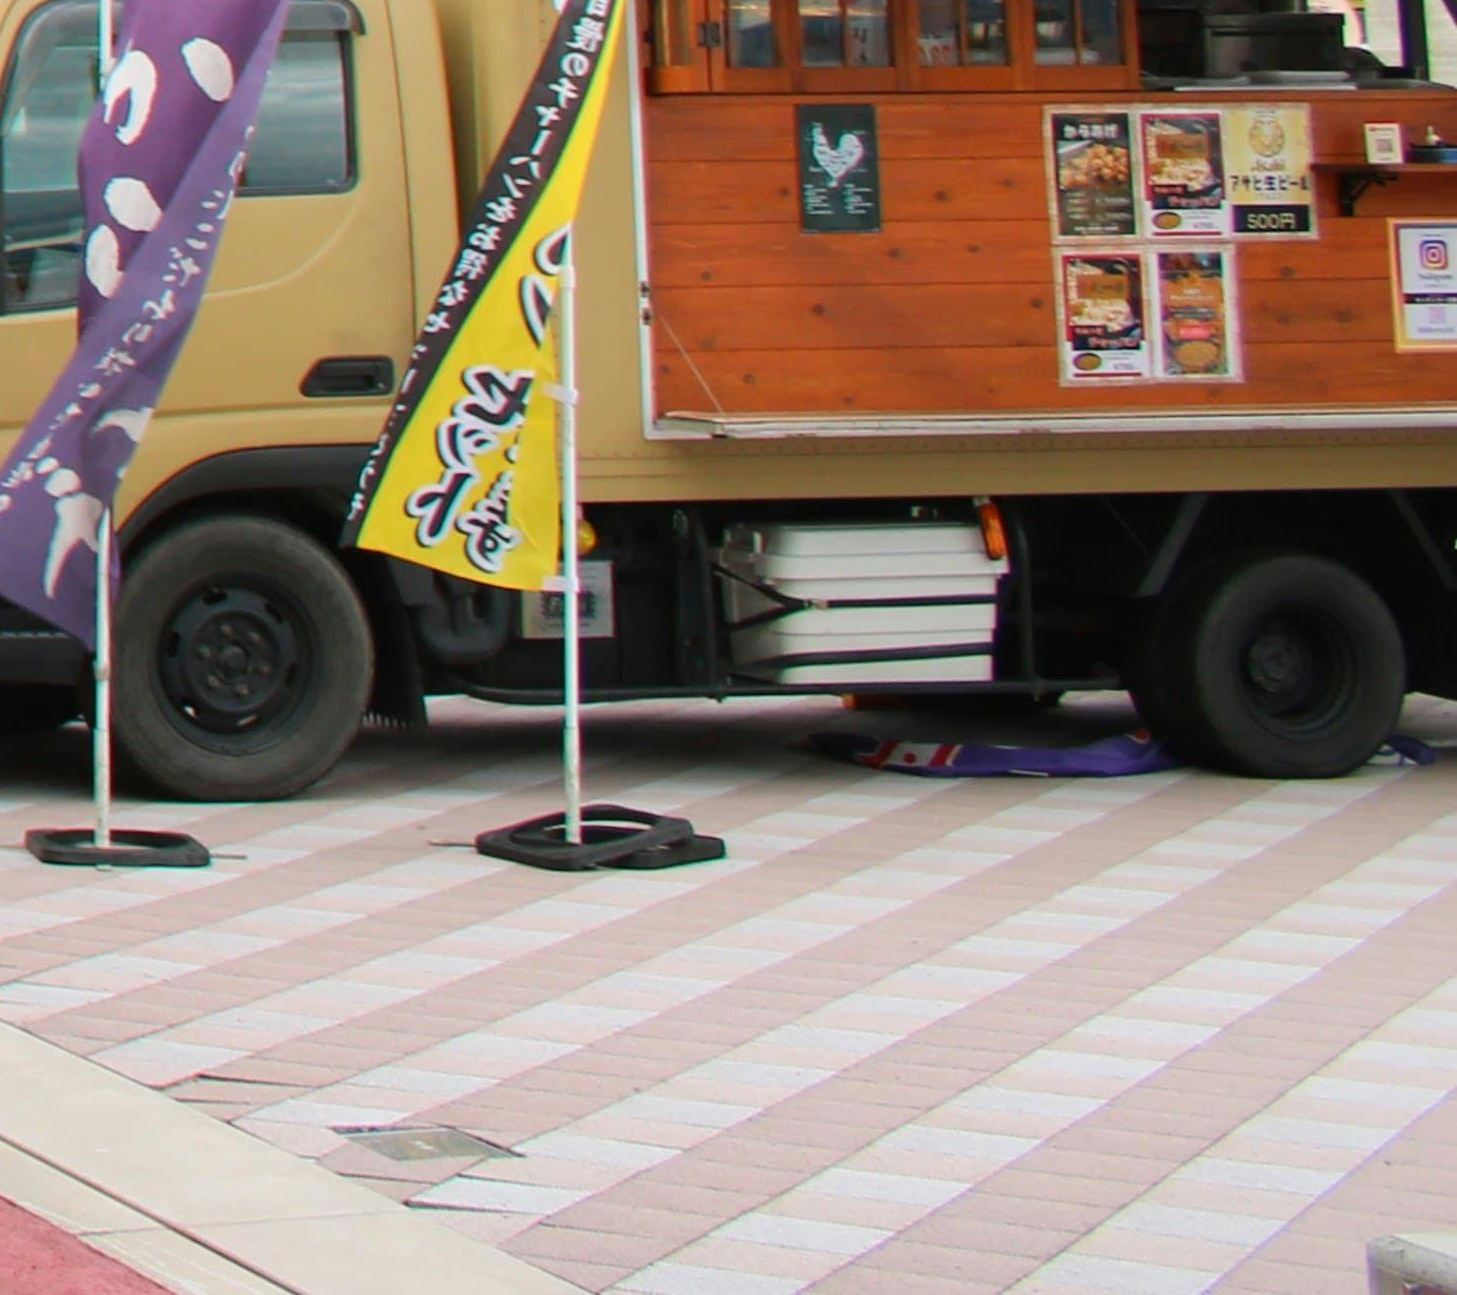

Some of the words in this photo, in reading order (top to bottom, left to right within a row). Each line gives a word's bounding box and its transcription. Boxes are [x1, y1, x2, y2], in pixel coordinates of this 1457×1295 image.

[1229, 174, 1308, 191] アサヒ生ビール
[1247, 213, 1295, 229] 500円
